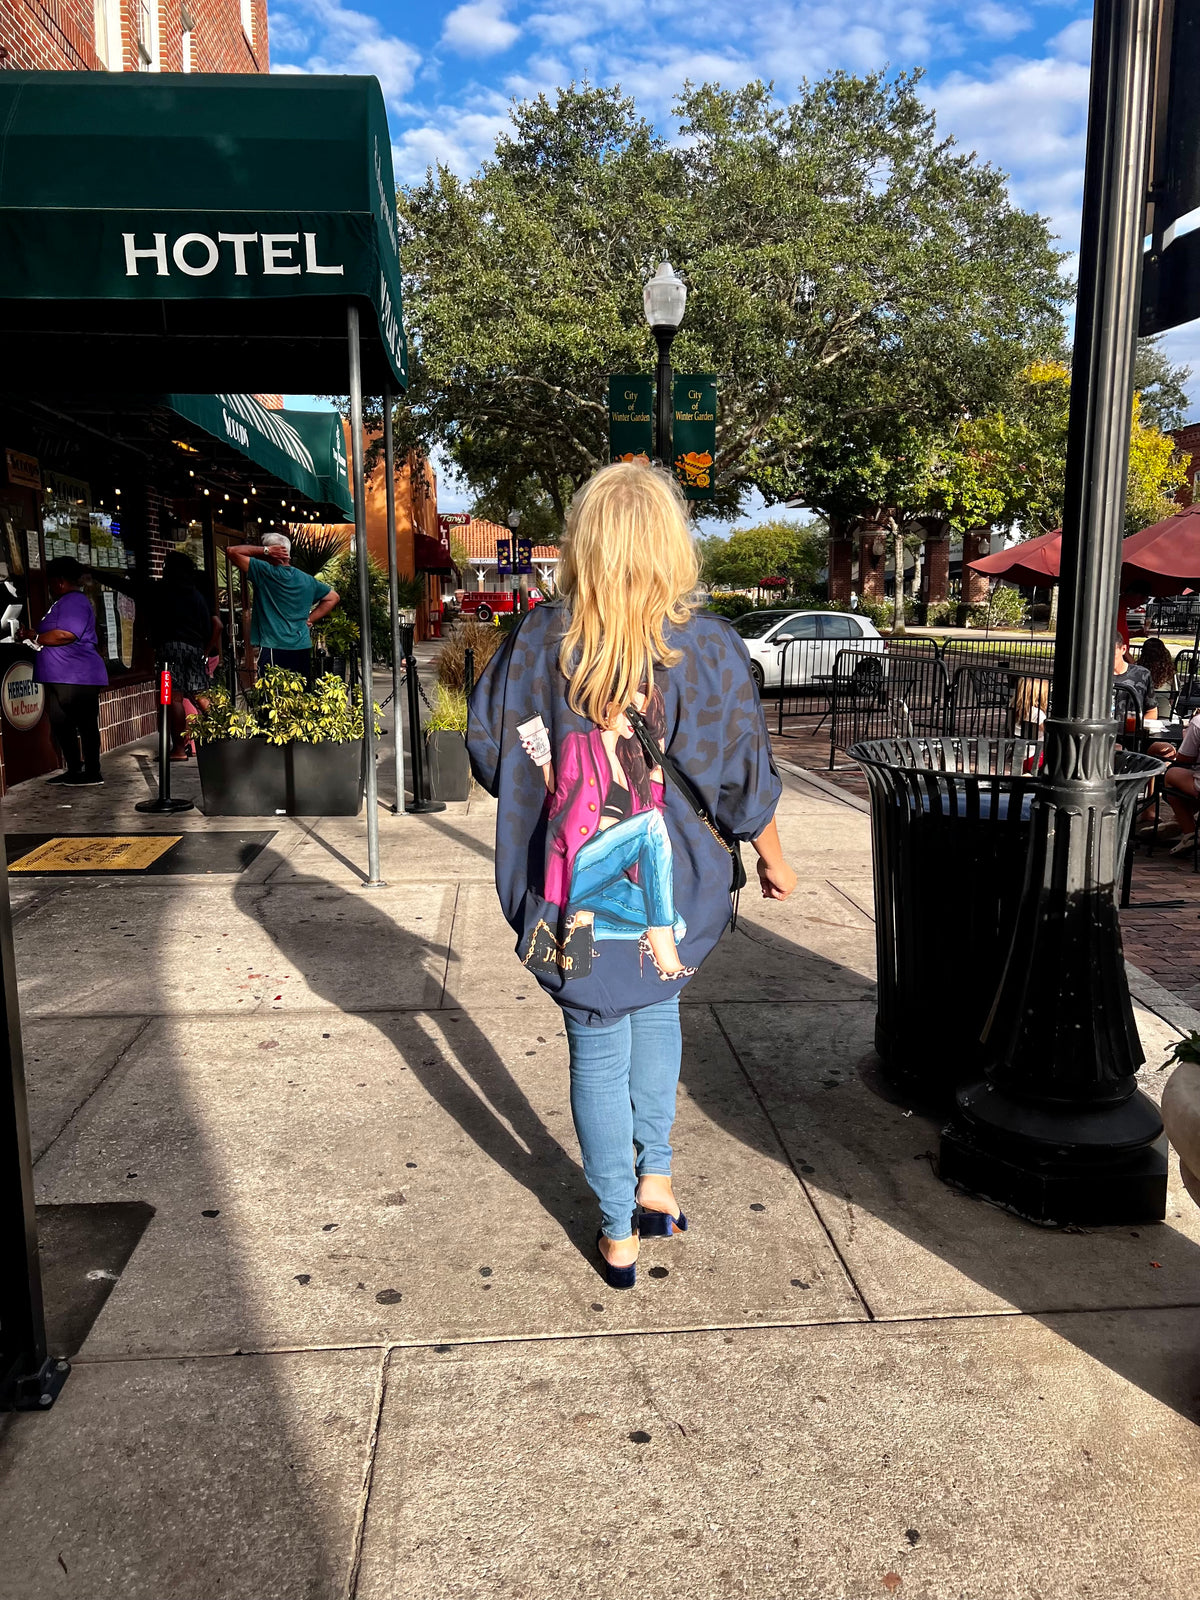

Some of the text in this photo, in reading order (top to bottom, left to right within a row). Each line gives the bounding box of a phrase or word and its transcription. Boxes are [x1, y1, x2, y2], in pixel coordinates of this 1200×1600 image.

[121, 231, 344, 276] HOTEL
[624, 391, 638, 402] City
[688, 390, 702, 401] City
[628, 402, 635, 411] of
[691, 402, 699, 410] of
[612, 411, 650, 422] Winter Garden
[675, 410, 714, 421] Winter Garden
[440, 514, 467, 524] Tony's
[8, 680, 39, 699] HERSHEYS
[11, 701, 40, 717] Ice Cream
